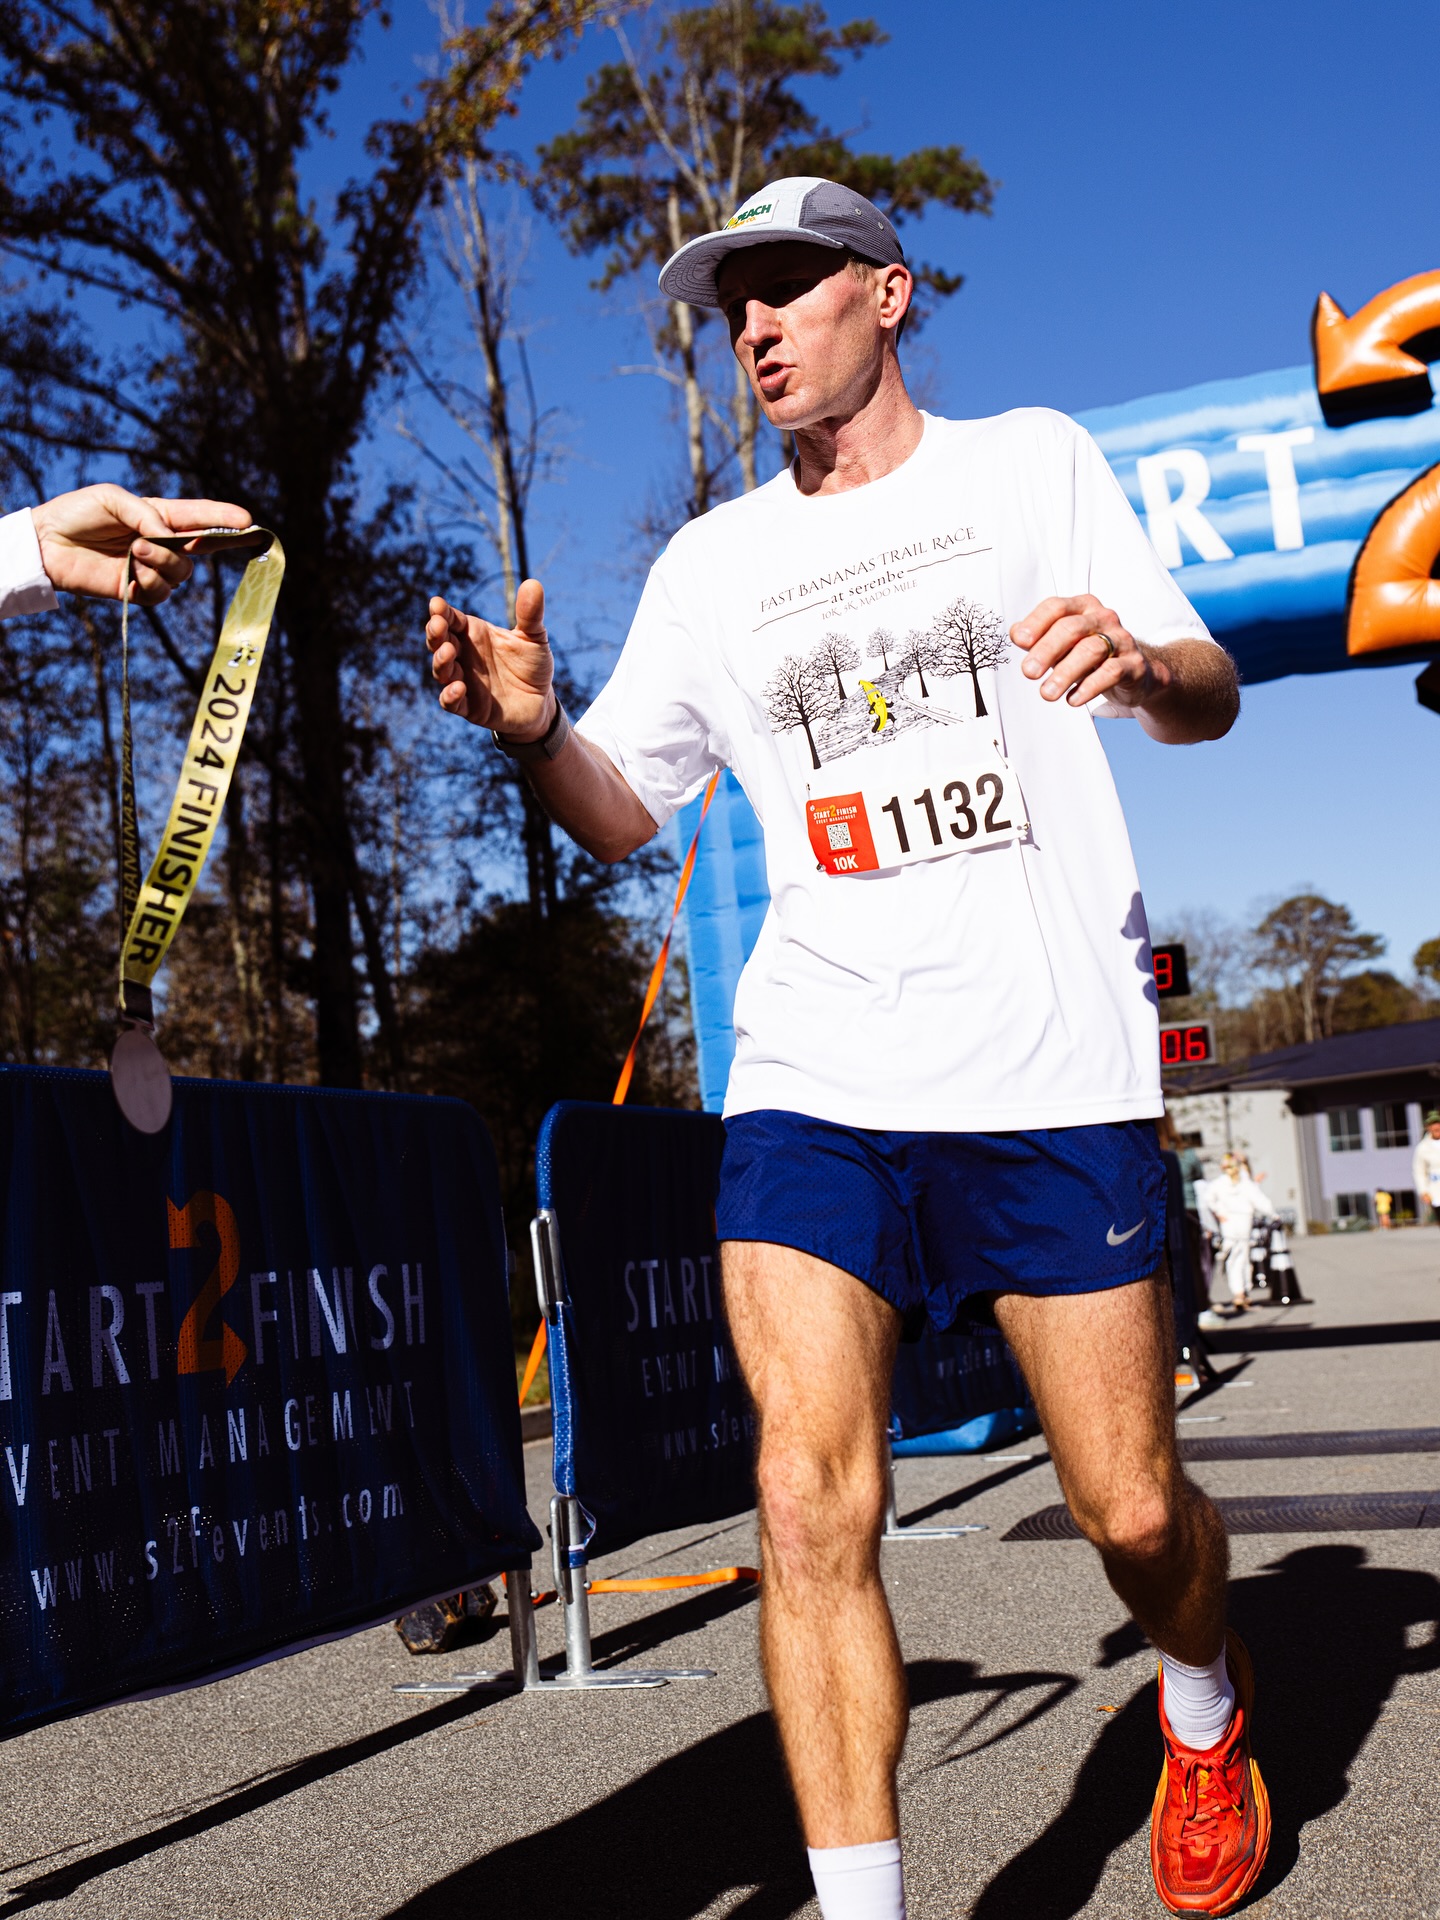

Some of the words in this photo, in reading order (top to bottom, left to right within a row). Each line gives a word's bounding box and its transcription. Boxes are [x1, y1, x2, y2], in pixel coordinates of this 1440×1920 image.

[735, 204, 772, 224] PEACH
[1136, 426, 1315, 570] RT
[760, 587, 795, 612] FAST
[798, 558, 876, 597] BANANAS
[877, 542, 928, 566] TRAIL
[932, 526, 976, 550] RACE
[831, 592, 844, 604] at
[848, 570, 904, 597] serenbe
[859, 587, 891, 607] MADO
[893, 579, 918, 594] MILE
[194, 673, 246, 770] 2024
[122, 788, 139, 902] BANANAS
[881, 772, 1012, 853] 1132
[127, 778, 219, 966] FINISHER
[833, 854, 859, 871] 10K
[1161, 1027, 1206, 1064] 06
[641, 1350, 697, 1398] EVENT
[5, 1427, 120, 1506] VENT
[158, 1380, 415, 1477] MANAGEMENT
[30, 1483, 405, 1611] www.s2fevents.com
